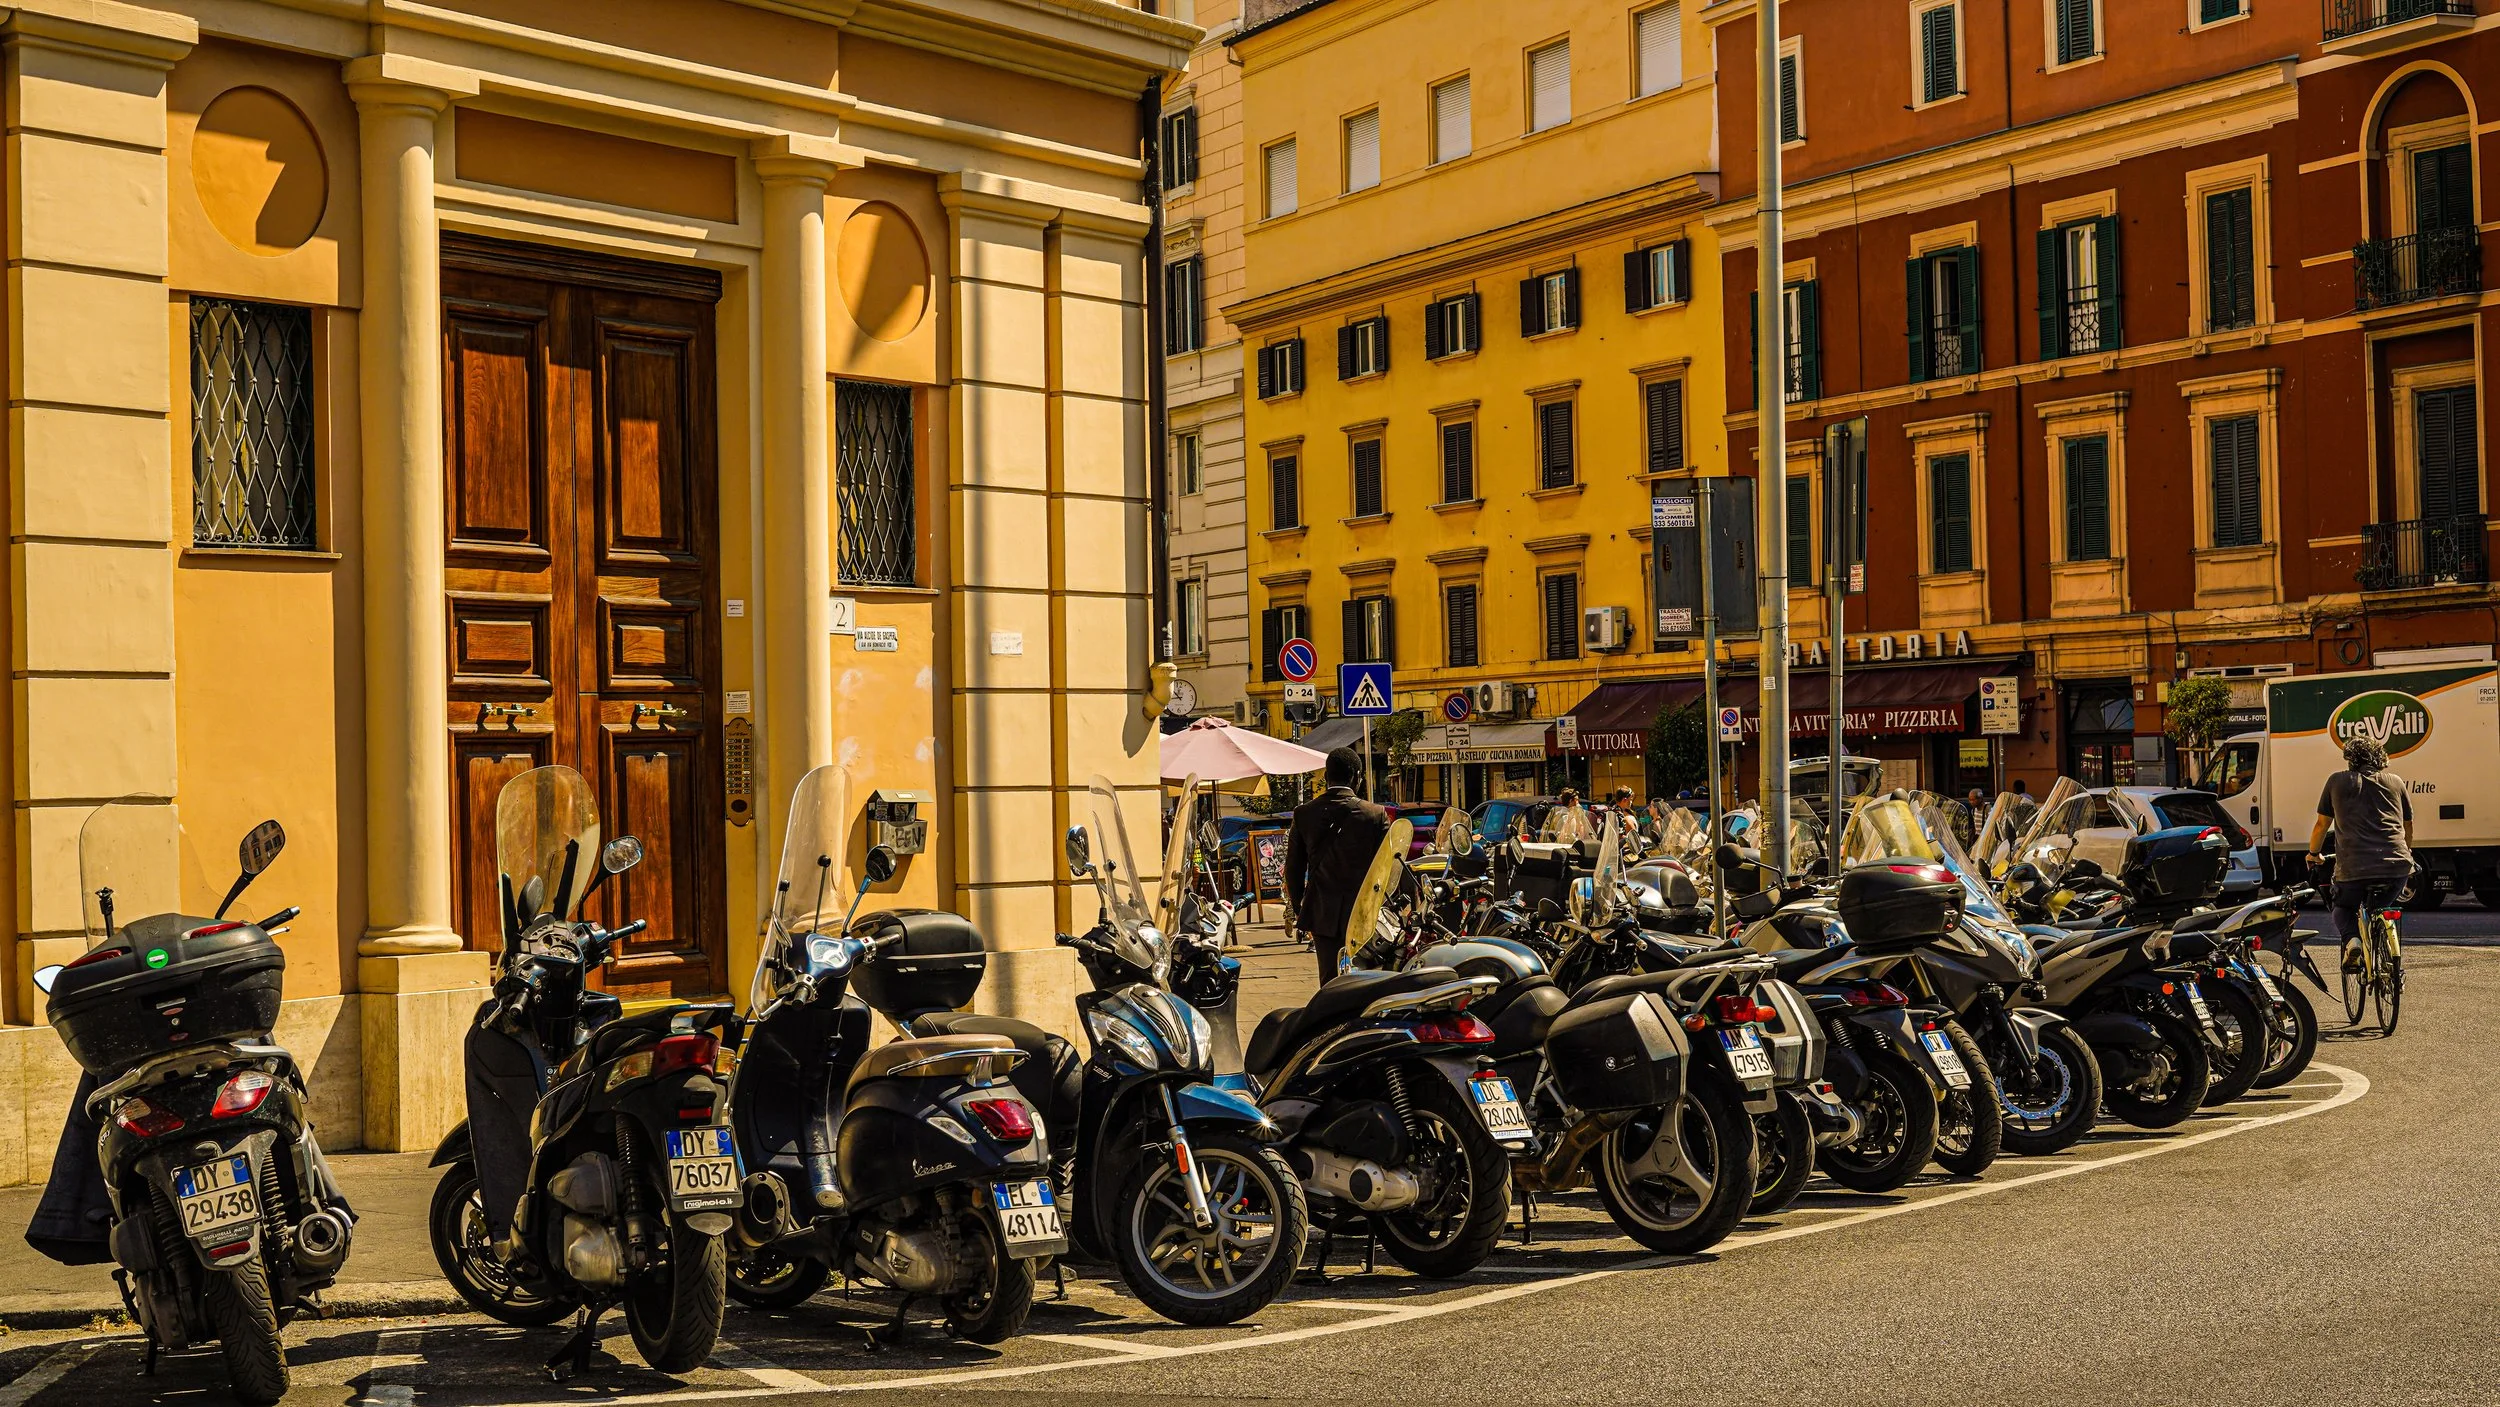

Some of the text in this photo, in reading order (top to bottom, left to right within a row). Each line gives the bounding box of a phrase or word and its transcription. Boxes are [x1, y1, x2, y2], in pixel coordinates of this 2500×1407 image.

[835, 602, 848, 628] 2
[1788, 630, 1970, 666] RATORIA
[1884, 709, 1959, 728] PIZZERIA
[1582, 733, 1641, 750] VITTORIA
[1489, 749, 1513, 760] CUCINA
[1514, 748, 1541, 760] ROMANA
[2411, 780, 2436, 794] latte
[1734, 1052, 1770, 1074] 47913
[1480, 1082, 1500, 1102] DC
[1483, 1105, 1525, 1127] 28404
[682, 1131, 705, 1156] DY
[192, 1163, 219, 1193] DY
[672, 1162, 733, 1190] 76037
[1007, 1183, 1033, 1207] EL
[186, 1188, 255, 1228] 29438
[1007, 1211, 1061, 1238] 48114
